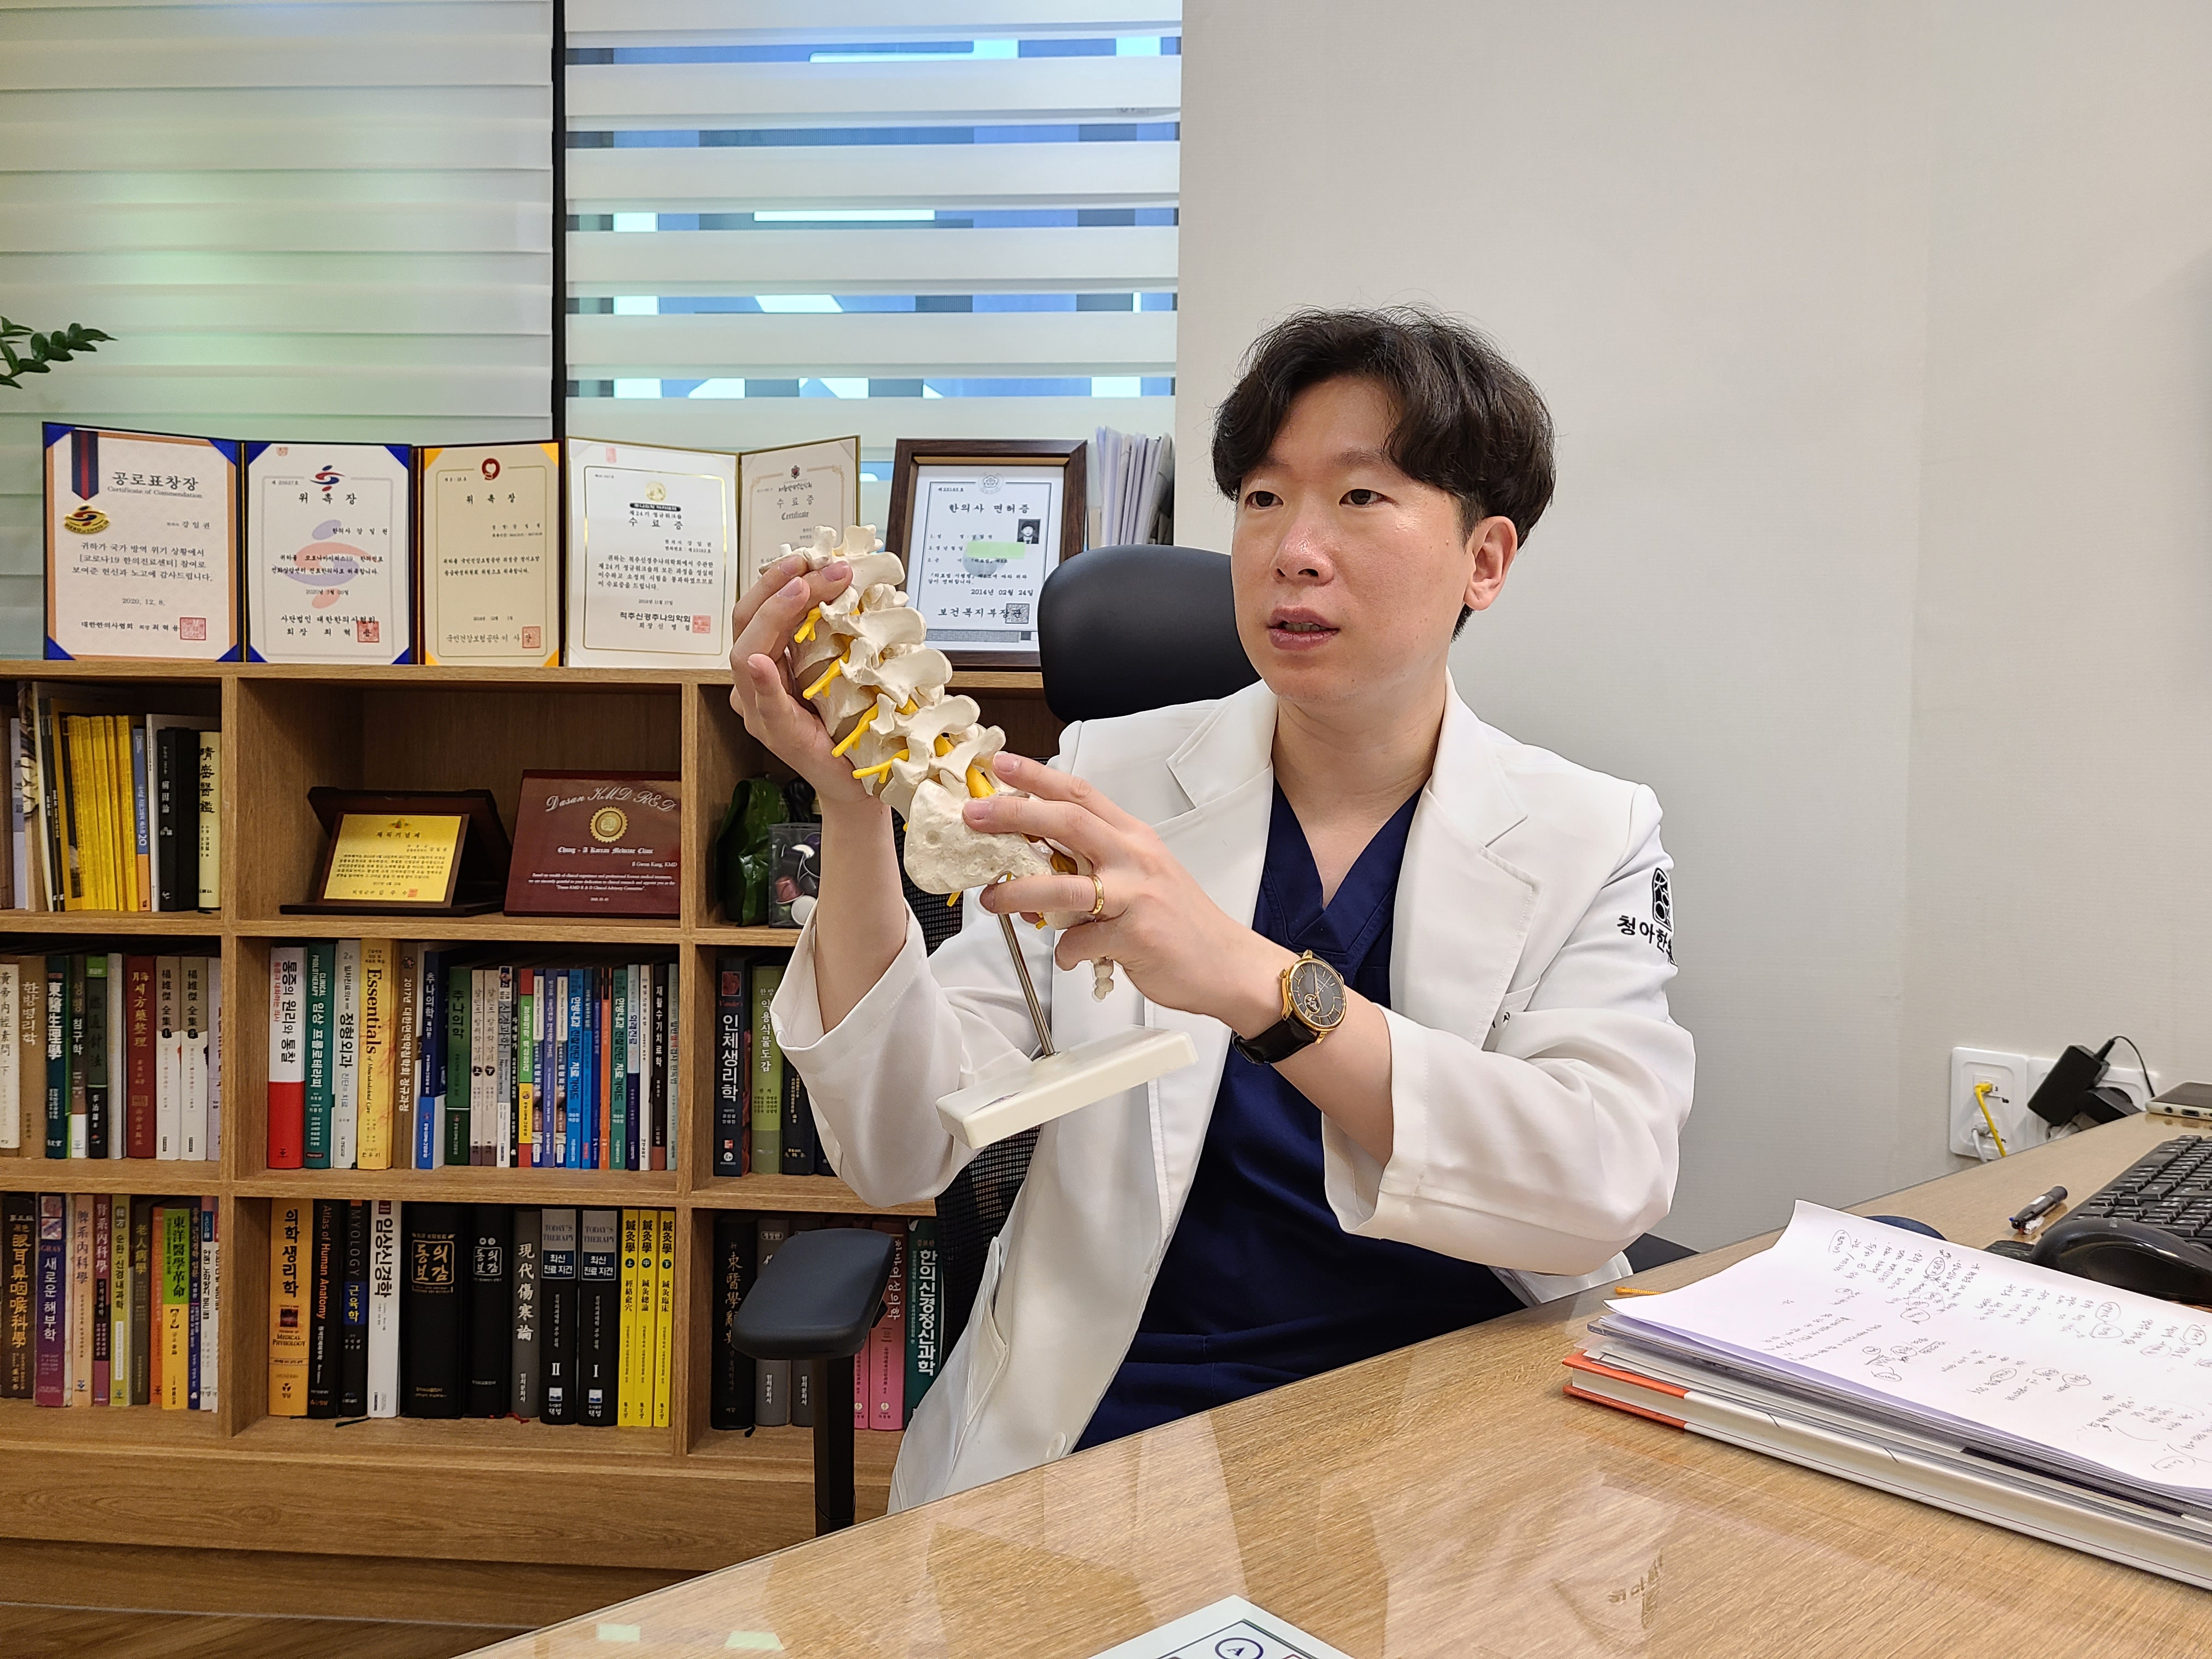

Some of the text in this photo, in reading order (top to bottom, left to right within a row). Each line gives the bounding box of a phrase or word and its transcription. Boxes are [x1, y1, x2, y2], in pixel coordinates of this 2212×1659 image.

[112, 472, 199, 491] 공로표창장
[154, 490, 202, 498] Commendation
[782, 511, 809, 520] Certificate
[949, 504, 1029, 514] 한의사 면허증
[111, 544, 127, 552] 국가
[171, 548, 204, 557] 상황에서
[132, 569, 156, 578] 노고에
[545, 795, 584, 812] Dasan
[311, 955, 319, 996] PROLOTHERAPY
[402, 978, 412, 1003] 2017년
[21, 982, 40, 1047] 한방병리학
[281, 960, 297, 1064] 통증의 원리와 통찰
[313, 1002, 325, 1026] 임상
[366, 968, 382, 1054] Essentials
[452, 990, 465, 1040] 추나의학
[570, 996, 582, 1027] 한방내과
[615, 997, 625, 1028] 한방내과
[340, 1013, 354, 1068] 정형외과
[628, 1014, 637, 1045] 외래진료
[760, 999, 772, 1073] 약용식물도감
[721, 1013, 738, 1102] 인체생리학
[399, 1077, 410, 1112] 정규과정
[323, 1205, 332, 1229] Atlas
[282, 1209, 300, 1297] 의학생리학
[319, 1243, 330, 1276] Human
[349, 1210, 361, 1277] MYOLOGY
[374, 1217, 393, 1298] 임상신경학
[550, 1254, 566, 1263] 최신
[590, 1255, 606, 1265] 최신
[544, 1265, 573, 1274] 진료 지견
[584, 1266, 613, 1276] 진료 지견
[43, 1257, 58, 1342] 새로운 해부학
[317, 1278, 330, 1319] Anatomy
[348, 1285, 360, 1323] 근육학
[516, 1243, 536, 1342] 現代傷寒論
[917, 1249, 938, 1376] 한의신경정신과학
